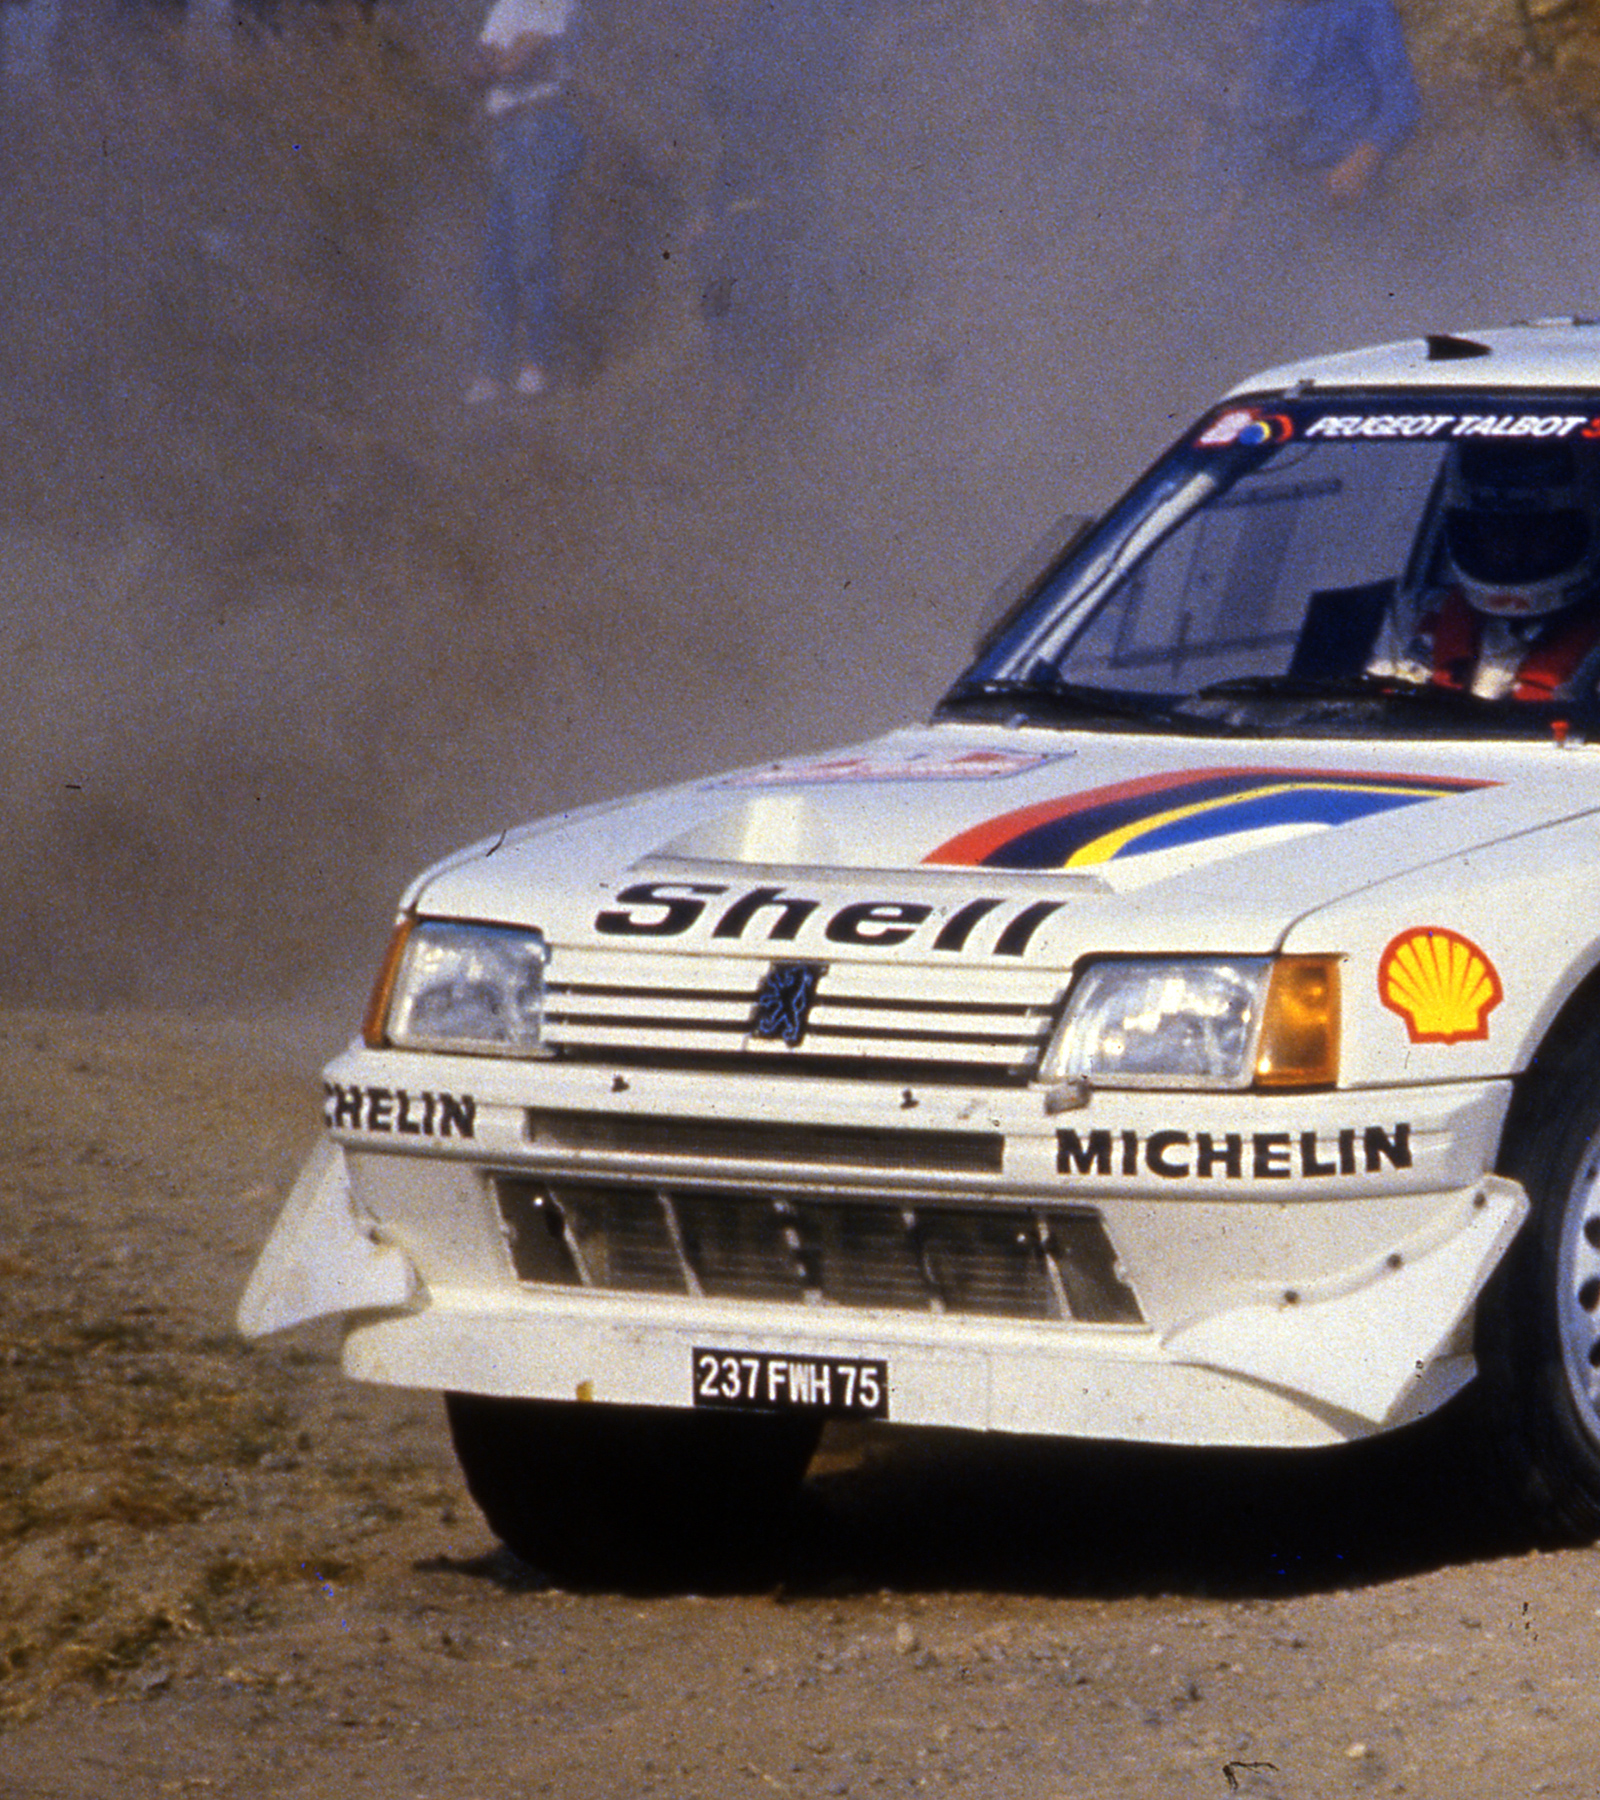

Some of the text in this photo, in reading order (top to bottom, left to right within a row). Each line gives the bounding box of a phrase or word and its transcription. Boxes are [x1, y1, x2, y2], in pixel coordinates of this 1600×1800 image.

[1304, 415, 1454, 438] PEUGEOT
[1451, 415, 1588, 438] TALBOT
[594, 882, 1068, 956] Shell
[1055, 1122, 1413, 1179] MICHELIN
